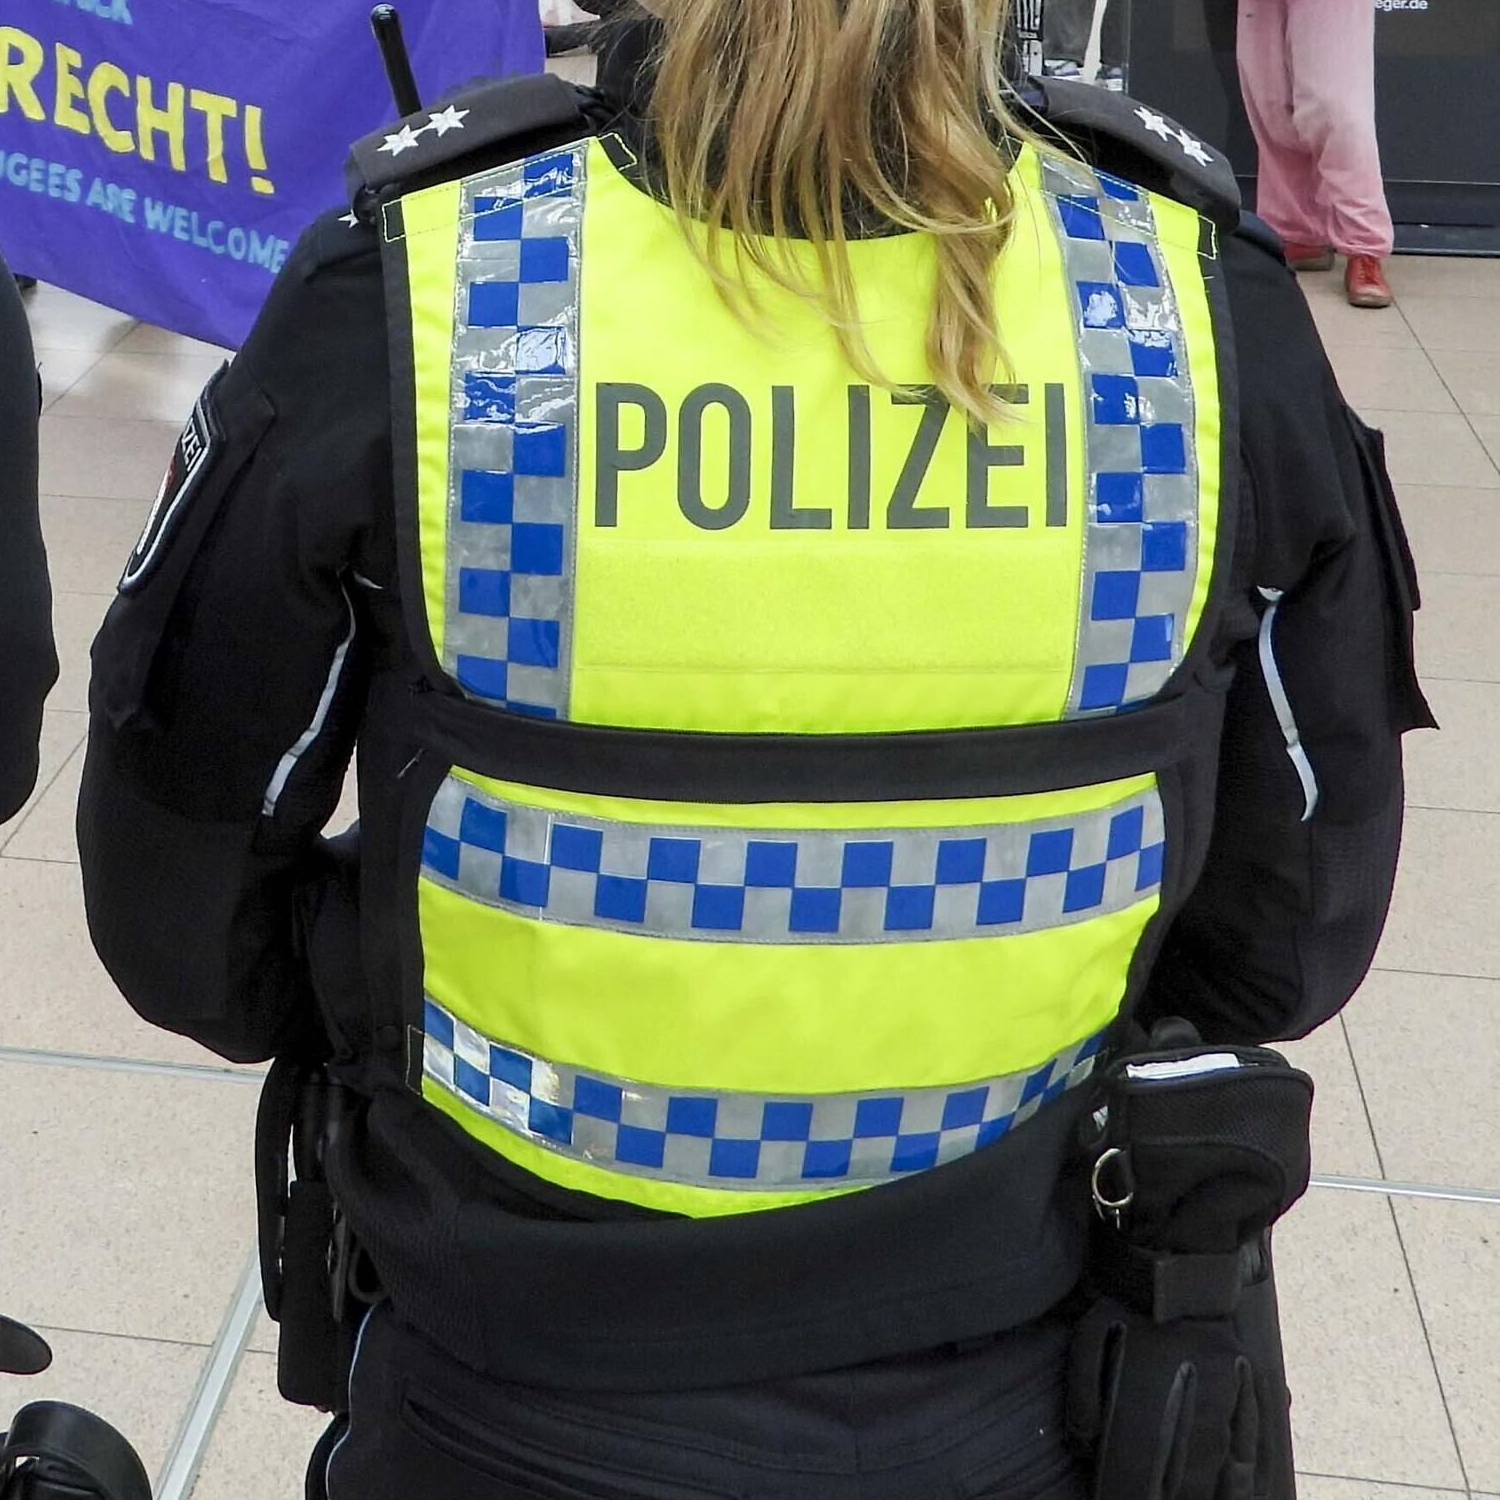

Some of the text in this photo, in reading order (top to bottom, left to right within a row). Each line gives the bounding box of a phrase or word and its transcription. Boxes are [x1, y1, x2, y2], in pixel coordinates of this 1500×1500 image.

[85, 177, 137, 224] ARE
[144, 197, 290, 274] WELCOME
[594, 382, 1068, 531] POLIZEI
